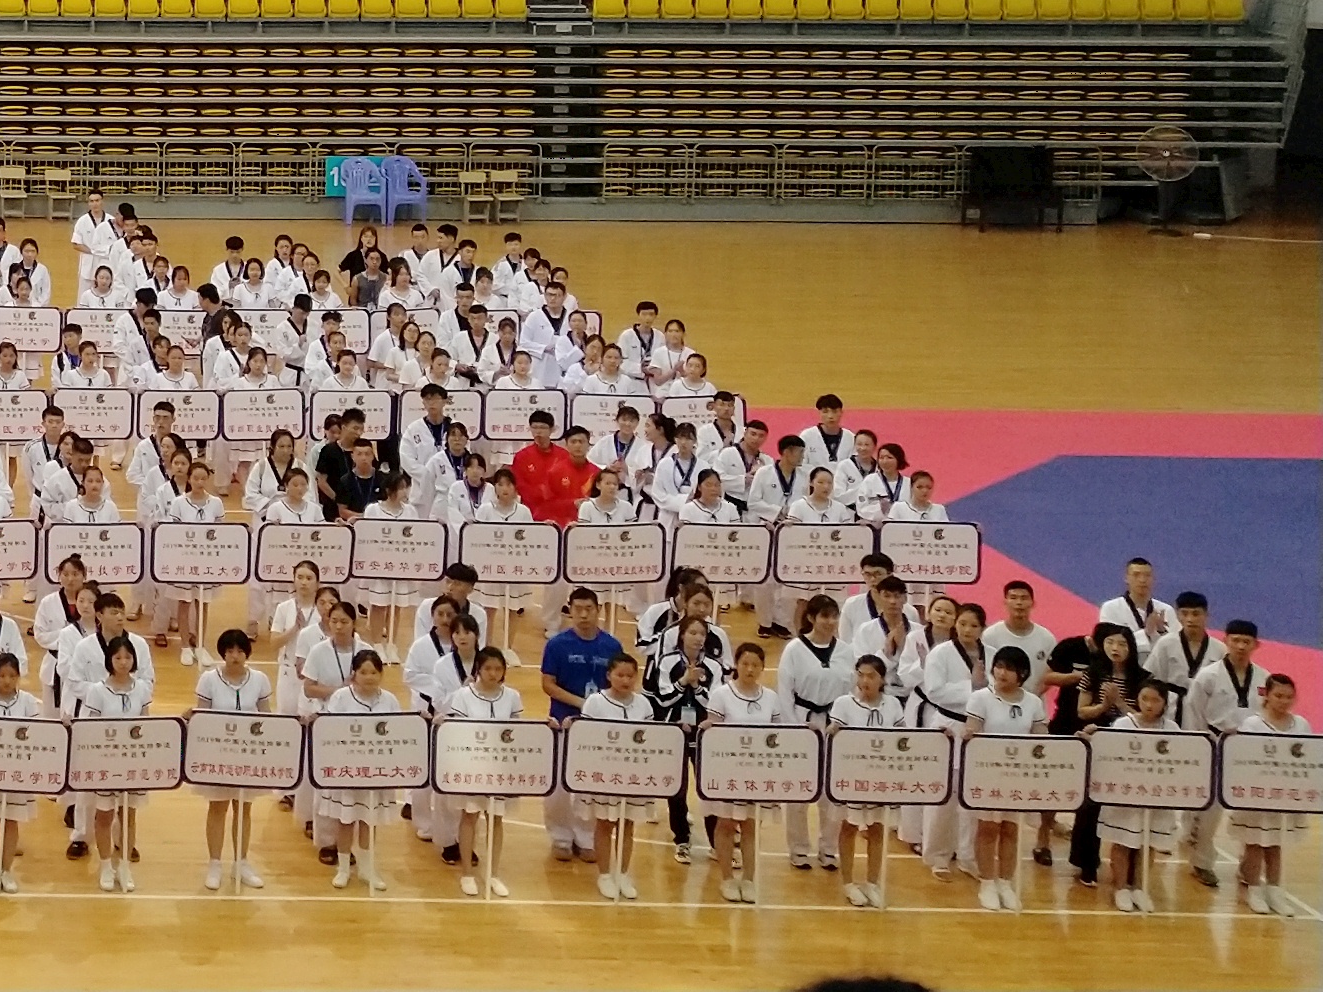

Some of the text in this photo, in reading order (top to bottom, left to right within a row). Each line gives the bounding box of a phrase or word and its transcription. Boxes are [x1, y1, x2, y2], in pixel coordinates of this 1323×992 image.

[70, 766, 177, 783] 湖南第一师范学院
[320, 765, 423, 780] 重庆理工大学
[574, 769, 675, 787] 安徽农业大学
[707, 778, 813, 794] 山东体育学院
[835, 779, 945, 795] 中国海洋大学
[970, 787, 1079, 803] 吉林农业大学
